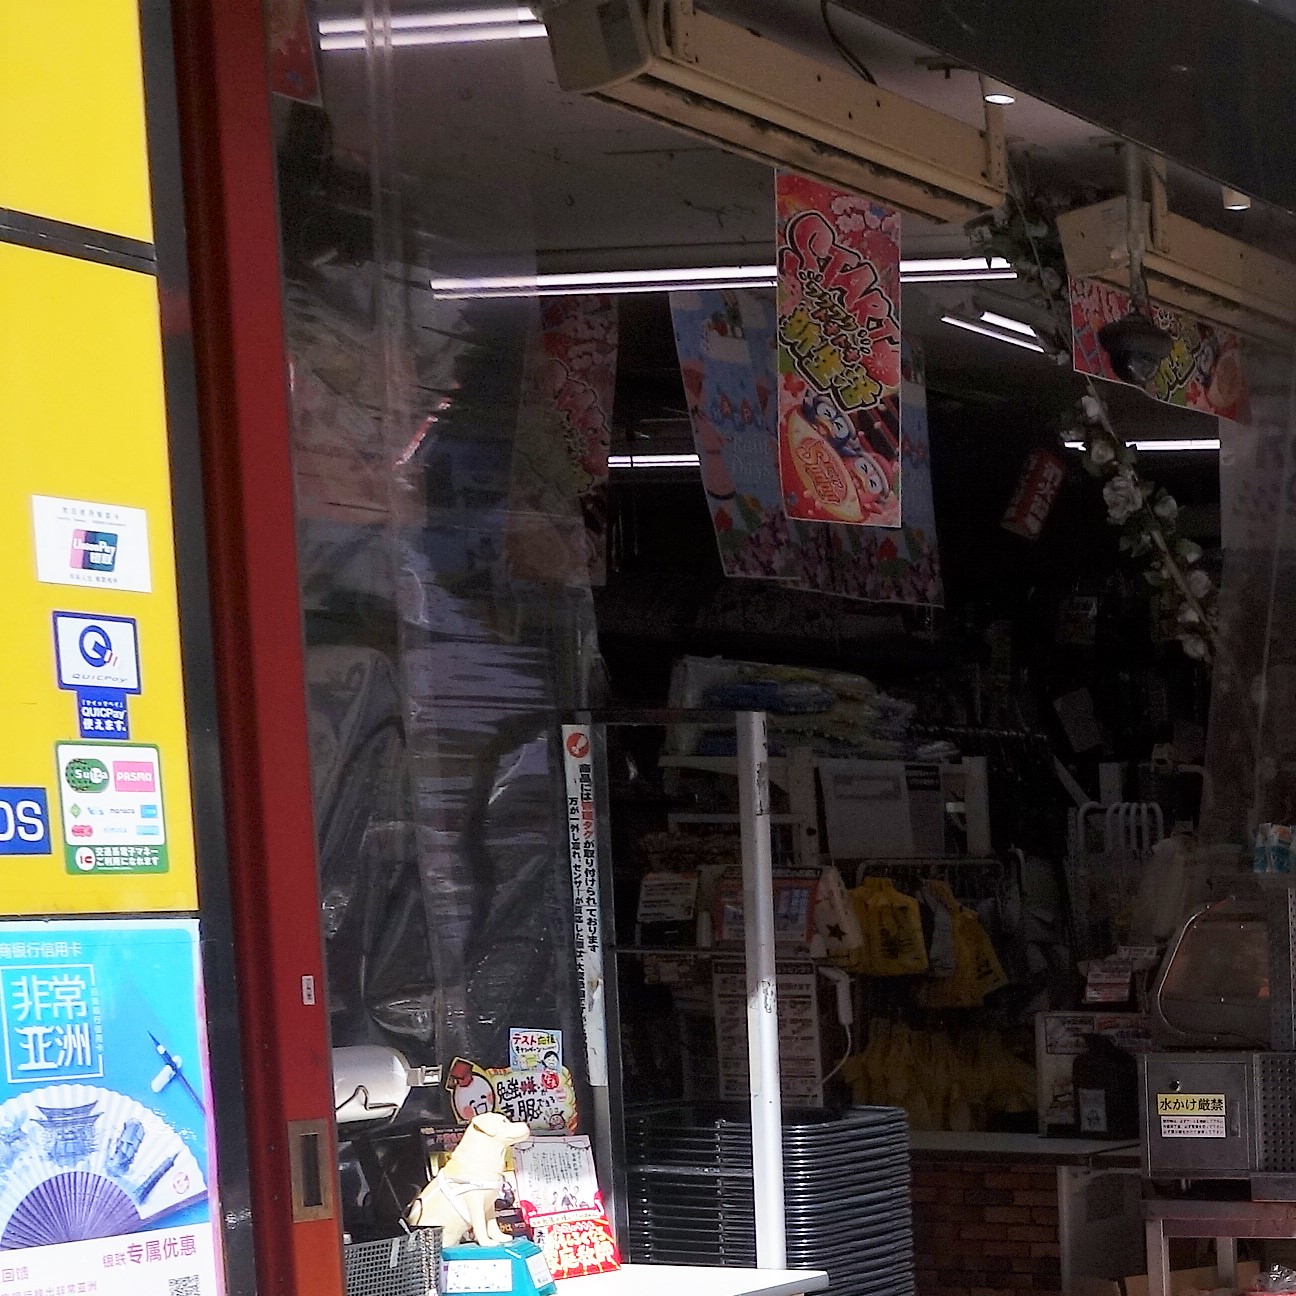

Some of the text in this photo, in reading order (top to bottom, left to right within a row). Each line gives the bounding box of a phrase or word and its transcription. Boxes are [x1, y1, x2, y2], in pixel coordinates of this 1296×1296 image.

[73, 540, 116, 555] UnionPay
[81, 706, 127, 720] QUICPay
[75, 768, 109, 784] Suica
[116, 770, 153, 783] PASMO
[10, 973, 88, 1021] 非常
[1159, 1097, 1224, 1112] 水かけ厳禁
